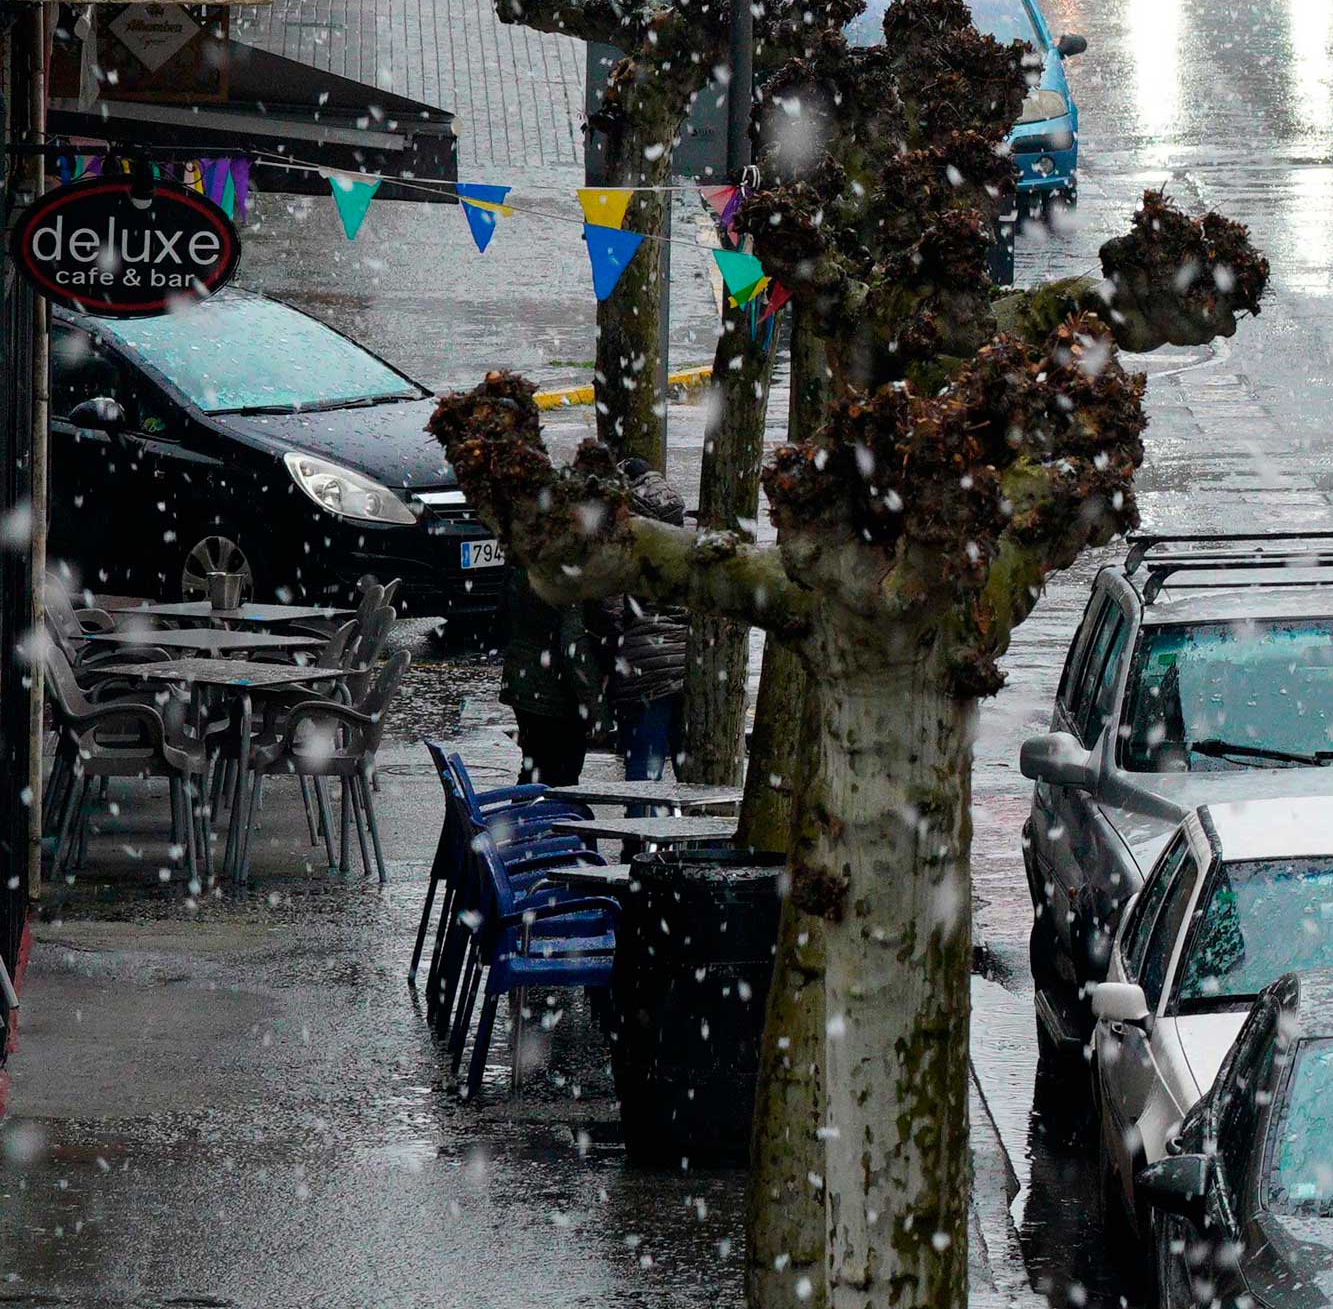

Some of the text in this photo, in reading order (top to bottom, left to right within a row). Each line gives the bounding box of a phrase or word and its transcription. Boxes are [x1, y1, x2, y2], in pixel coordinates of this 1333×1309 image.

[32, 214, 221, 266] deluxe
[55, 266, 196, 288] cafe & bar
[472, 542, 506, 564] 794
